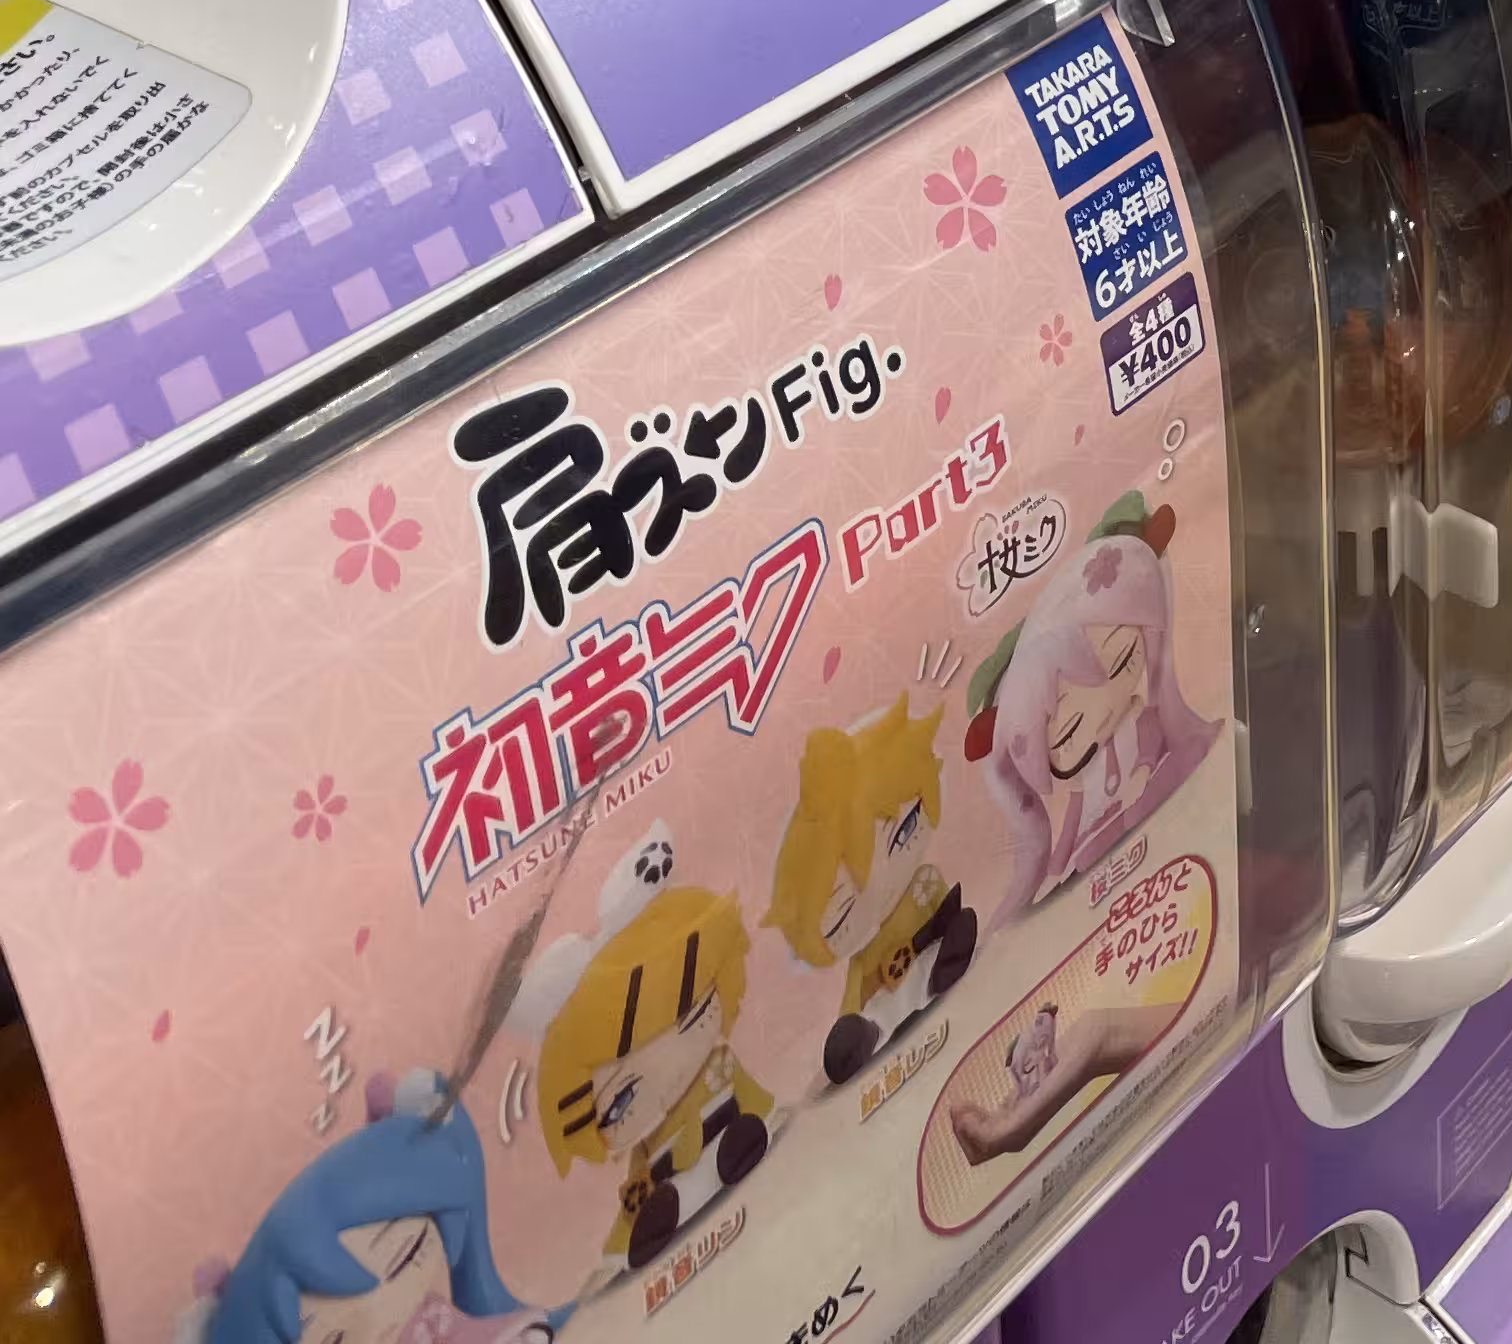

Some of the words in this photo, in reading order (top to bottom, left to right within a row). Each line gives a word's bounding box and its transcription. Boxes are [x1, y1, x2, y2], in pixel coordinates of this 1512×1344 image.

[1025, 44, 1112, 107] TAKARA
[1036, 66, 1120, 136] TOMY
[1054, 94, 1135, 169] A.R.T.S
[1075, 174, 1172, 264] 対象年齢
[1095, 230, 1184, 309] 6才以上
[1119, 315, 1192, 389] ¥400
[1129, 296, 1175, 347] 全4種
[454, 338, 904, 646] 肩ズンFig.
[843, 418, 1007, 585] Part3
[417, 521, 827, 897] 初音ミク
[467, 809, 597, 915] HATSUNE
[605, 750, 673, 815] MIKU
[1105, 857, 1192, 933] ころんと
[1095, 903, 1178, 977] 手のひら
[1182, 1200, 1241, 1294] 03
[1201, 1256, 1242, 1312] OUT
